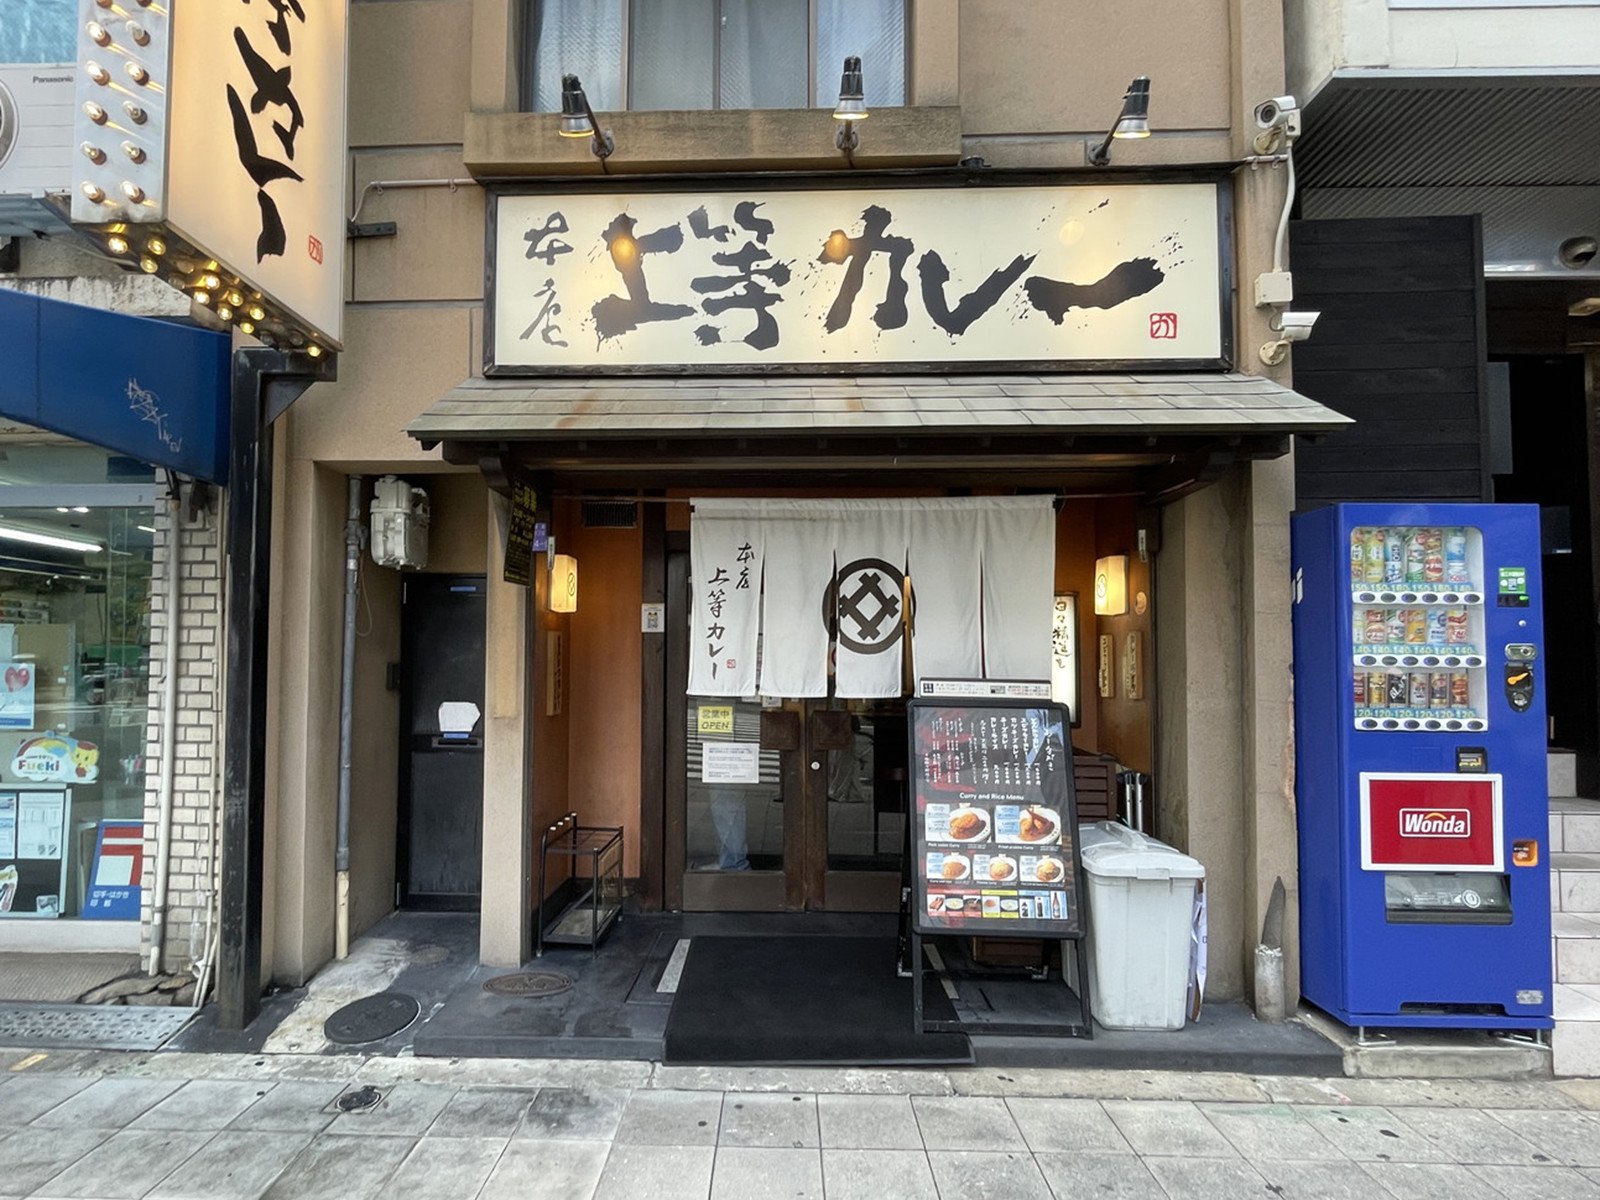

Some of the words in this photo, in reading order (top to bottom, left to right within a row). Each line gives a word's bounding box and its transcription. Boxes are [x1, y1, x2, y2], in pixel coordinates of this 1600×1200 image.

[33, 75, 73, 83] Panasonic
[519, 211, 575, 348] 本店
[592, 201, 1166, 350] 上等カレー
[736, 542, 755, 590] 本店
[706, 566, 730, 680] 上等カレー
[701, 721, 729, 730] OPEN
[702, 709, 729, 719] 営業中
[990, 717, 999, 750] カレーライス
[18, 760, 60, 771] Fueki
[1405, 813, 1465, 834] Wonda
